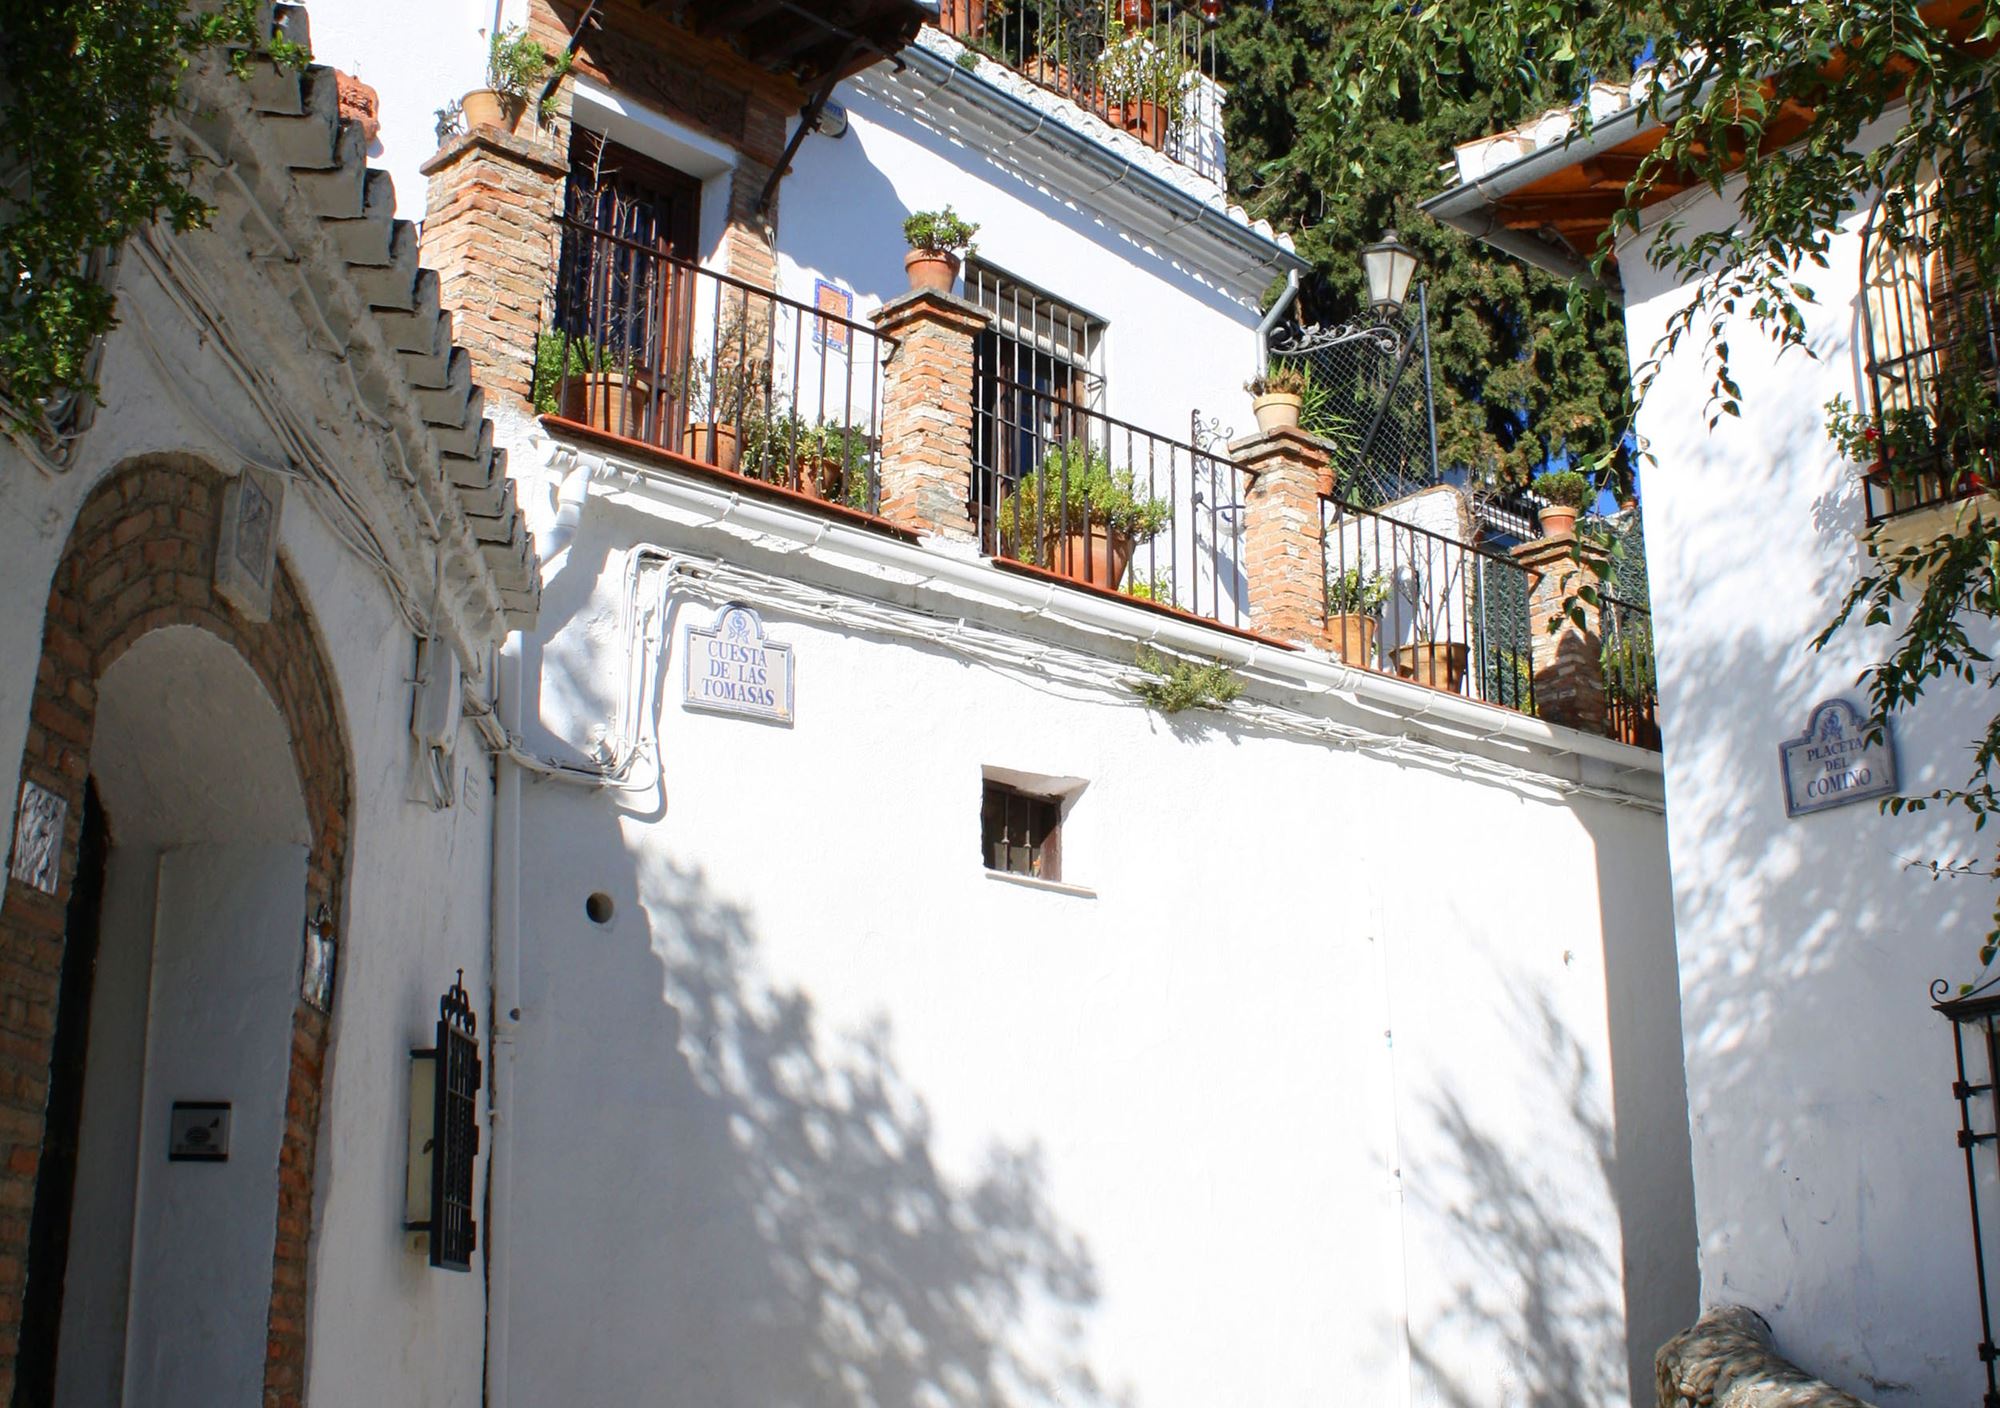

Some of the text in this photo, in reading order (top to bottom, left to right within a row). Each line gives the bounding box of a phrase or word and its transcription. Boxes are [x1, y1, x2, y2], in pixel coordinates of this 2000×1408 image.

[708, 640, 768, 668] CUESTA
[710, 659, 767, 685] DE LAS
[702, 678, 775, 706] TOMASAS
[1807, 737, 1863, 761] PLACETA
[1824, 758, 1850, 772] DEL
[1807, 768, 1871, 798] COMINO
